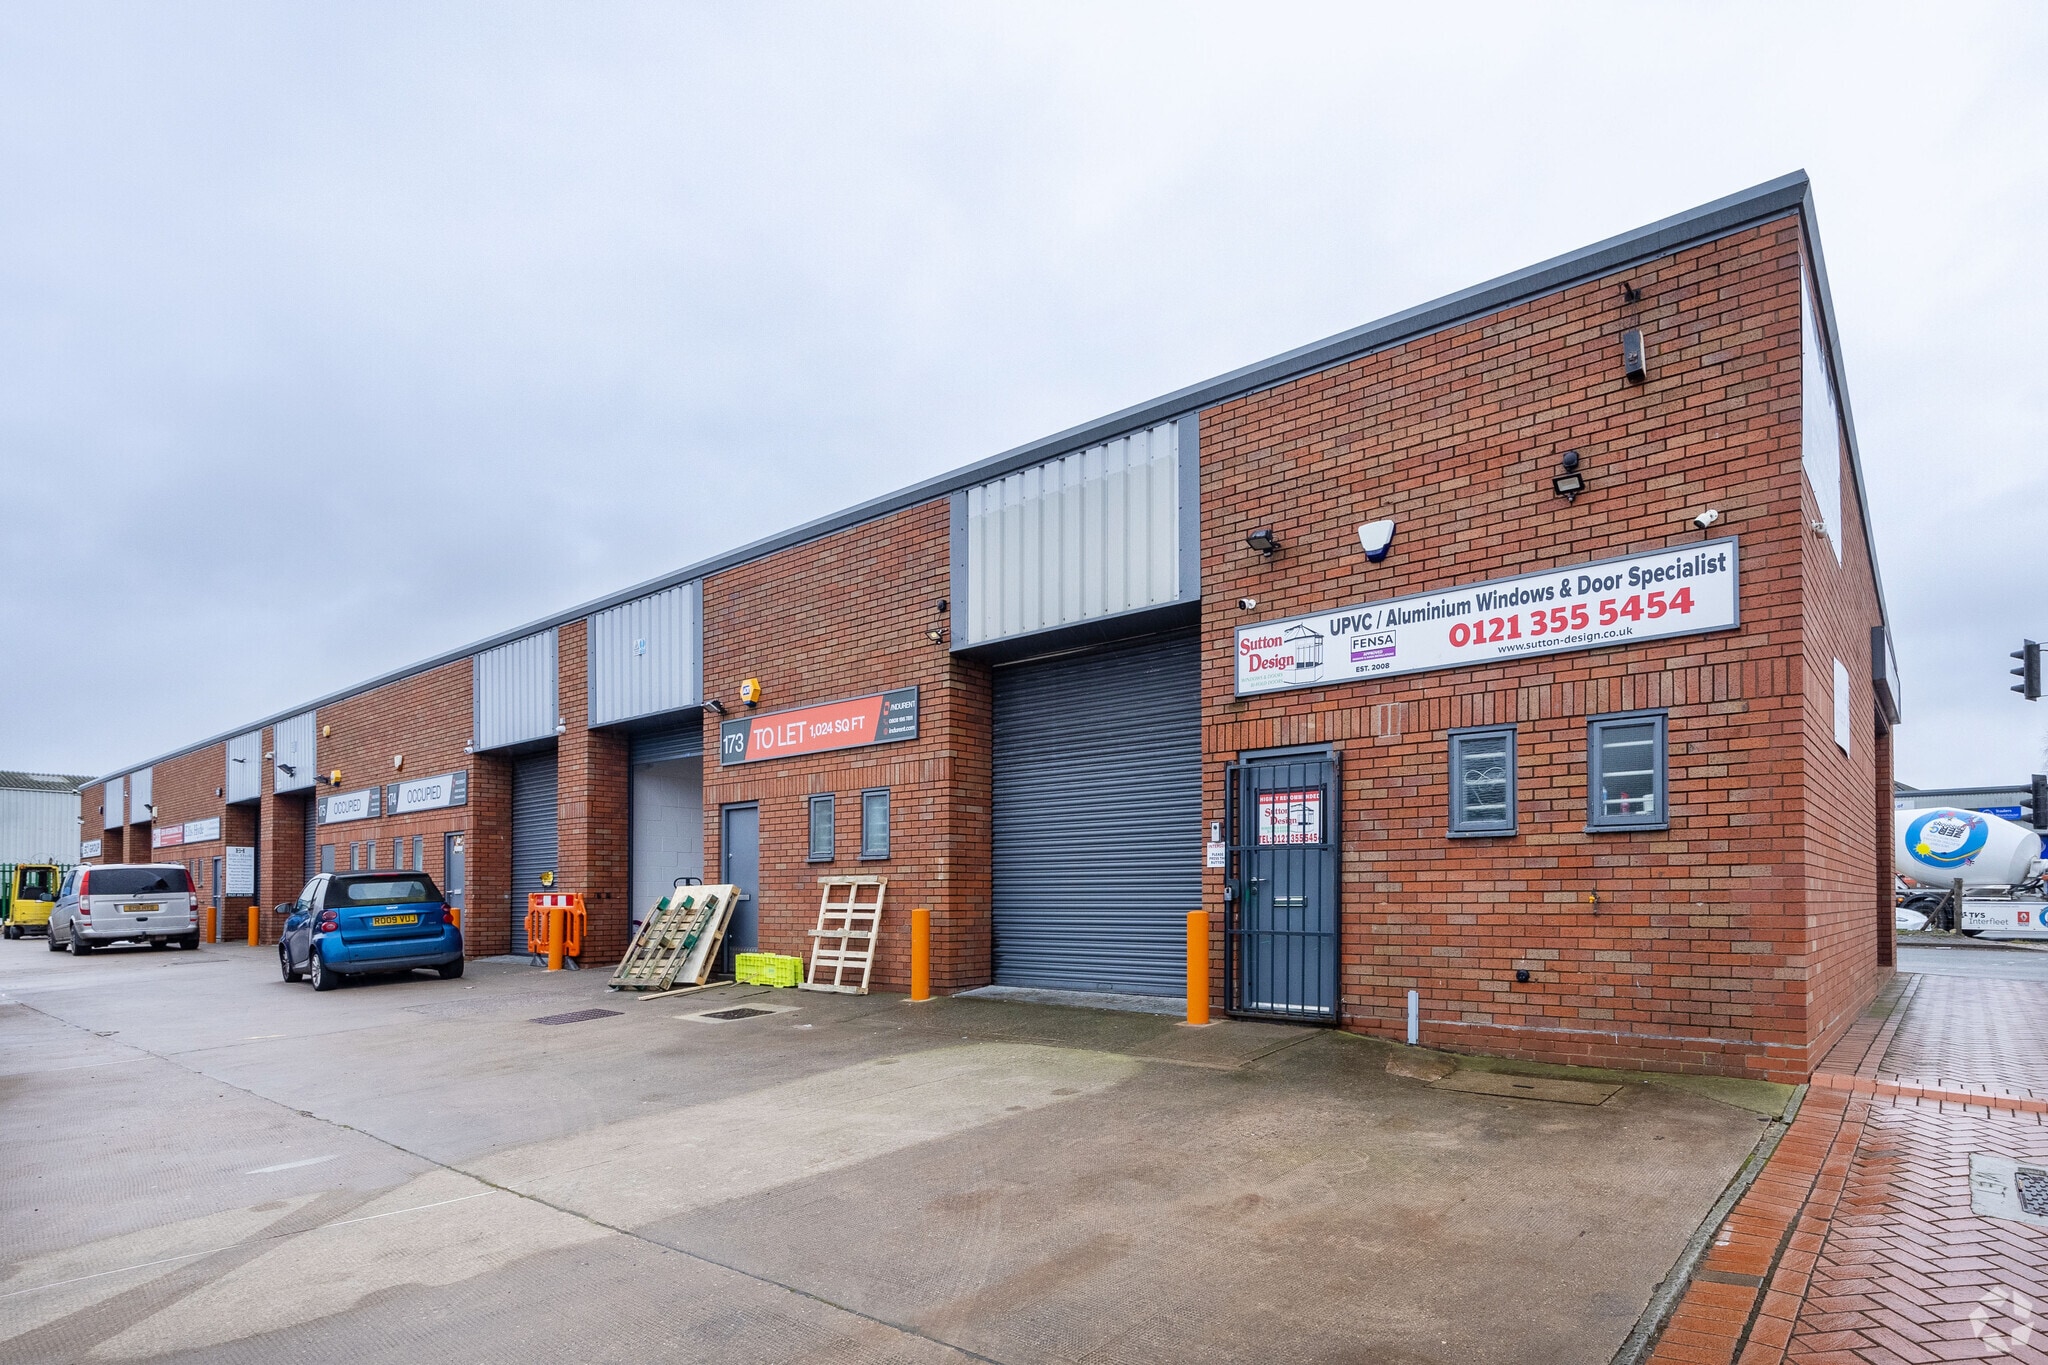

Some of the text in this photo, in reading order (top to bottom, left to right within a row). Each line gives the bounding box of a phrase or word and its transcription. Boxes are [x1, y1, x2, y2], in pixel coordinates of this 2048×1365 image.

[1329, 552, 1727, 636] UPVC / Aluminium Windows & Door Specialist
[1448, 586, 1695, 648] 0121 355 5454
[1240, 635, 1283, 656] Sutton
[1353, 634, 1394, 650] FENSA
[1497, 626, 1633, 653] www.sutton-design.co.uk
[1248, 653, 1295, 673] Design
[1355, 662, 1390, 673] EST. 2008
[753, 715, 865, 751] TO LET 1,024 SQ FT
[722, 732, 744, 754] 173
[387, 793, 397, 806] 174
[407, 785, 442, 804] OCCUPIED
[1260, 795, 1279, 803] HIGHY
[333, 798, 361, 815] OCCUPIED
[374, 915, 398, 925] RO09
[399, 914, 417, 923] VUJ
[1968, 917, 2009, 926] Interfleet
